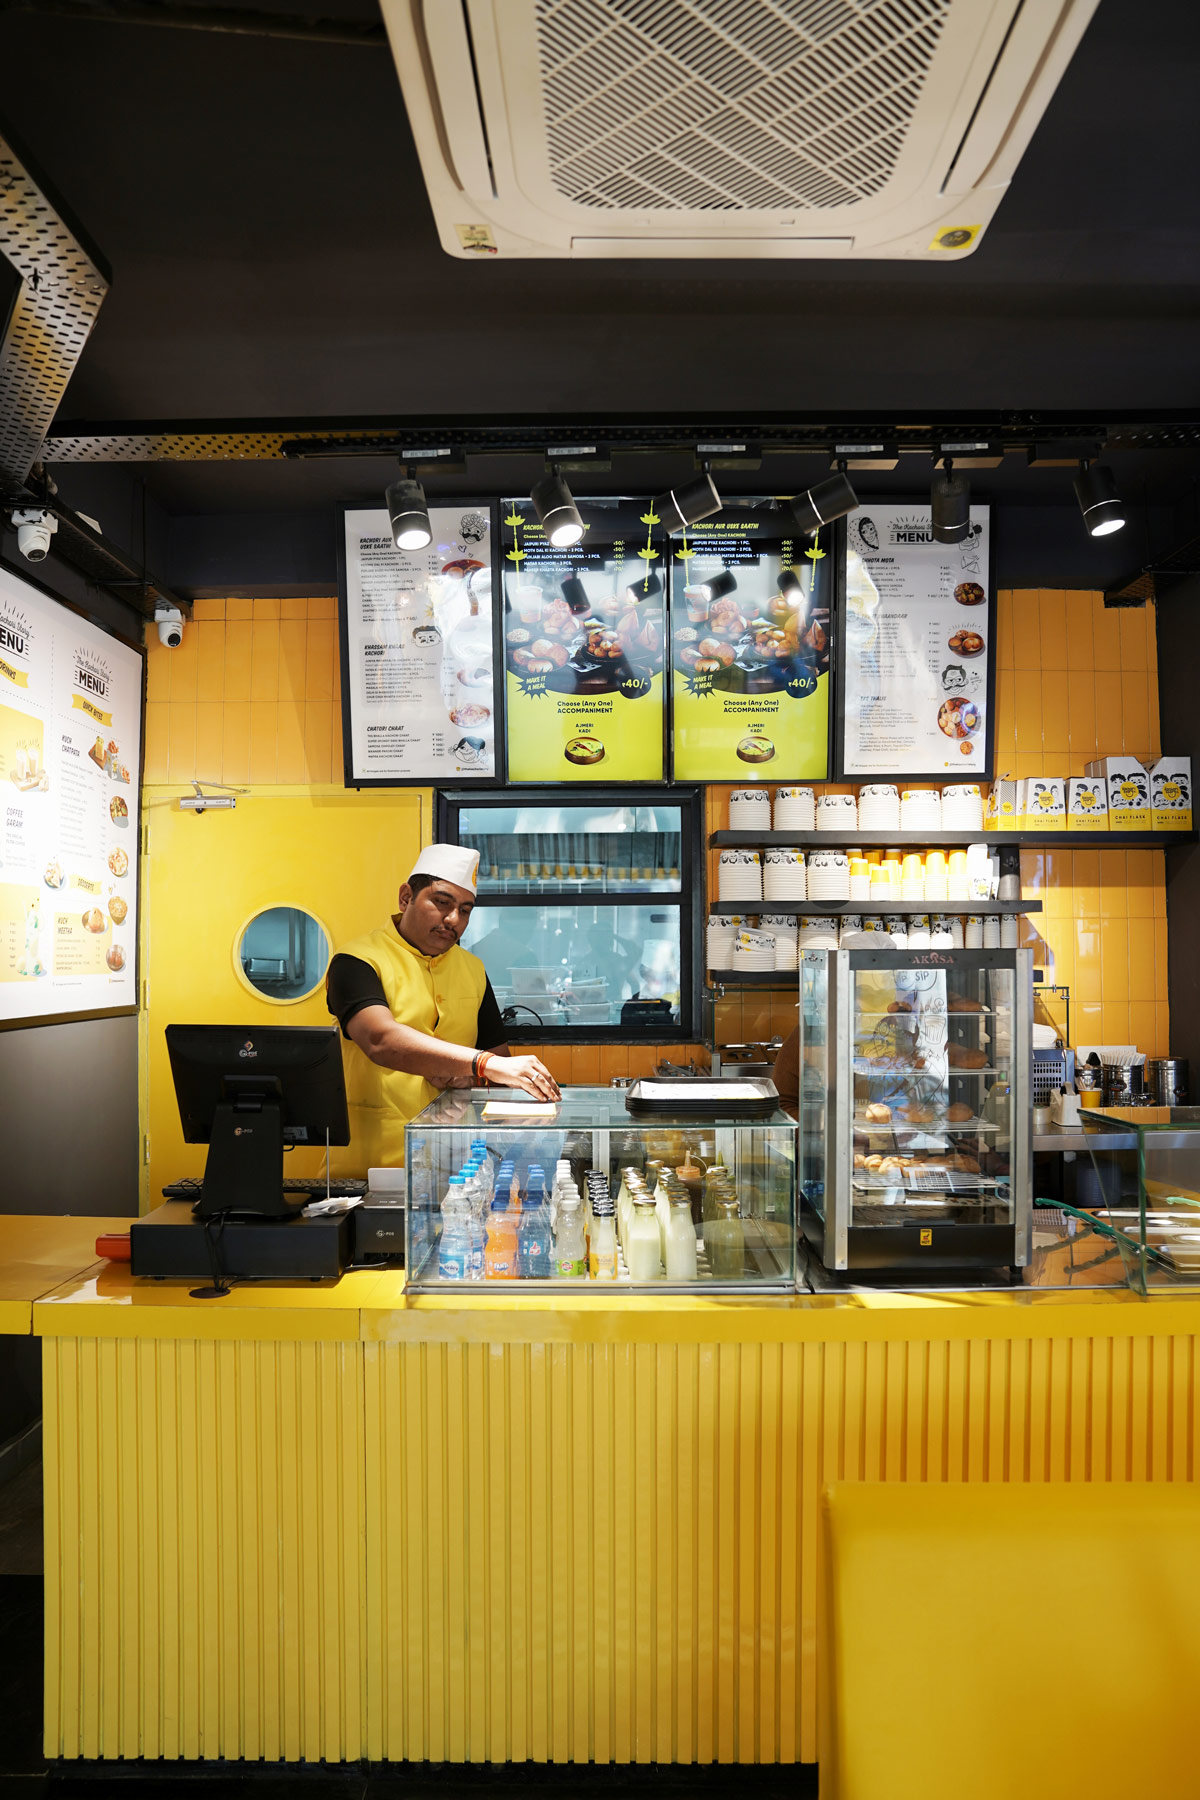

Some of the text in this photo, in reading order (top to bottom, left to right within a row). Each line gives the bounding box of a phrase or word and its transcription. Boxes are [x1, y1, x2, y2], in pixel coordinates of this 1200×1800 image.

[896, 533, 934, 542] MENU
[79, 670, 105, 696] MENU
[526, 676, 541, 684] MAKE
[693, 675, 707, 683] MAKE
[532, 682, 546, 690] MEAL
[582, 700, 596, 708] (Any
[912, 952, 954, 964] AKASA
